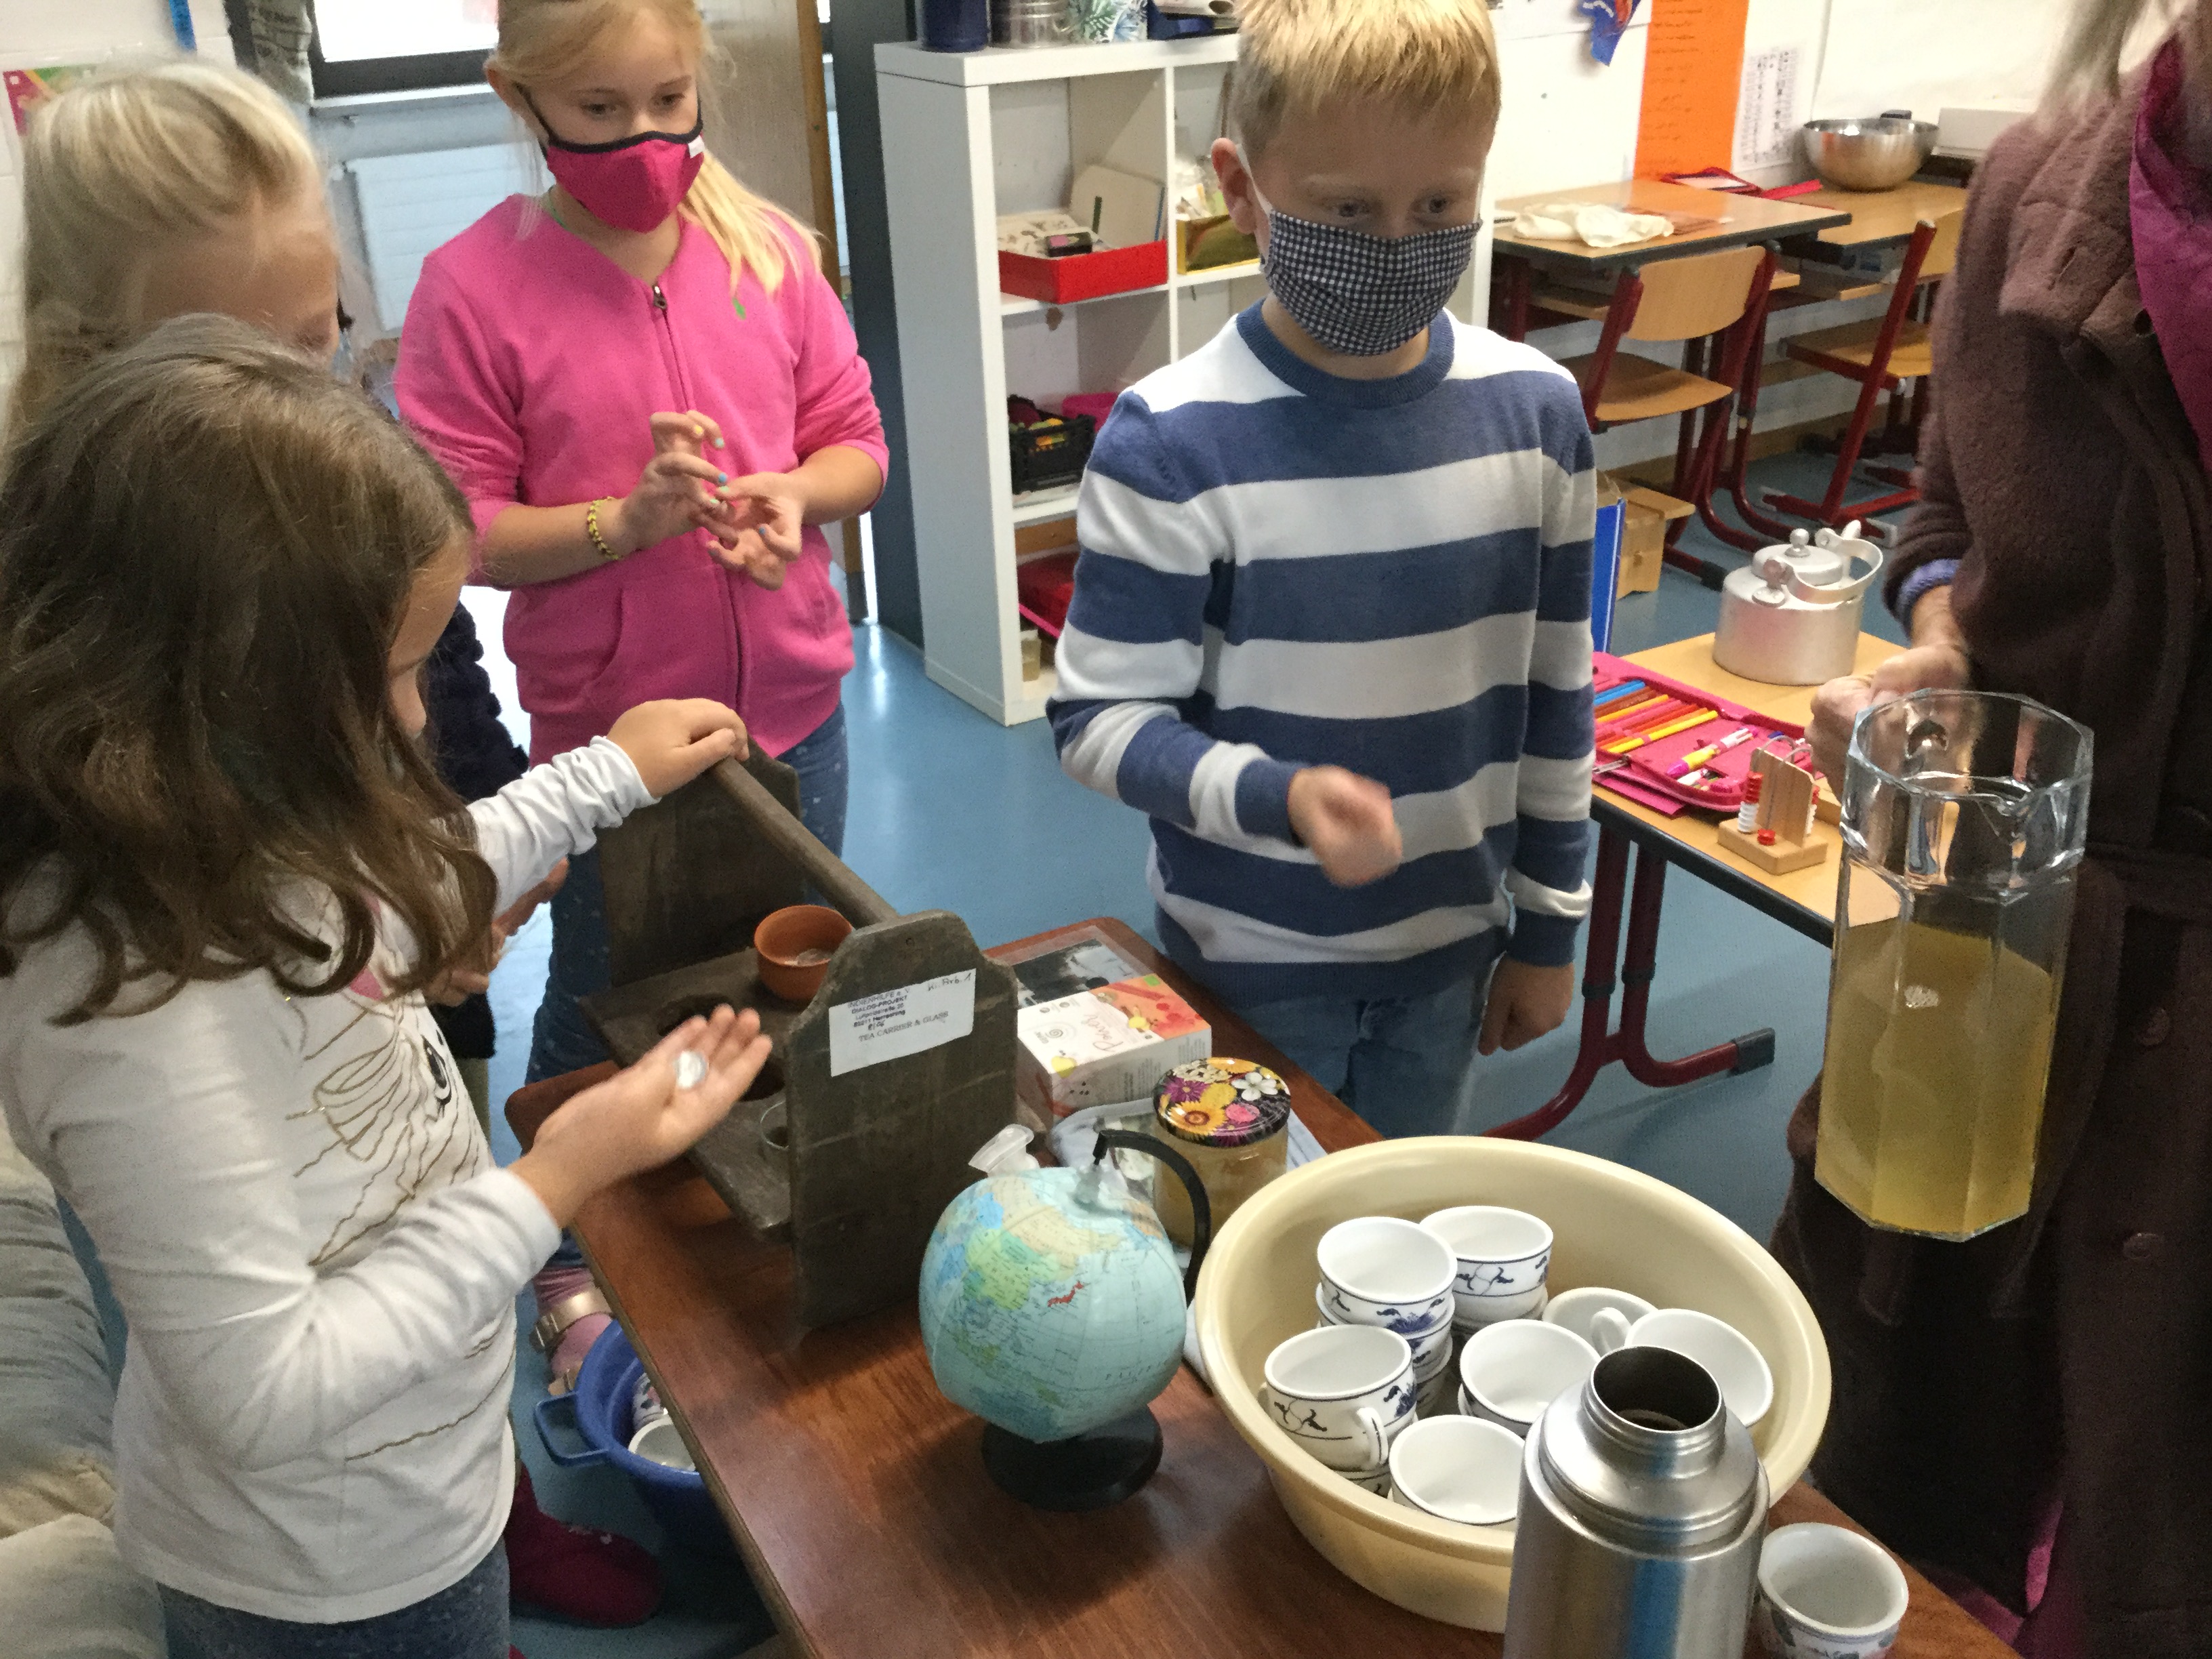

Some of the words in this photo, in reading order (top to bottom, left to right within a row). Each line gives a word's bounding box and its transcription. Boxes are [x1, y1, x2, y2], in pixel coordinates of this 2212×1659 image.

[858, 1032, 876, 1042] TEA
[877, 1021, 913, 1037] CARRIER
[922, 1010, 949, 1024] GLASS
